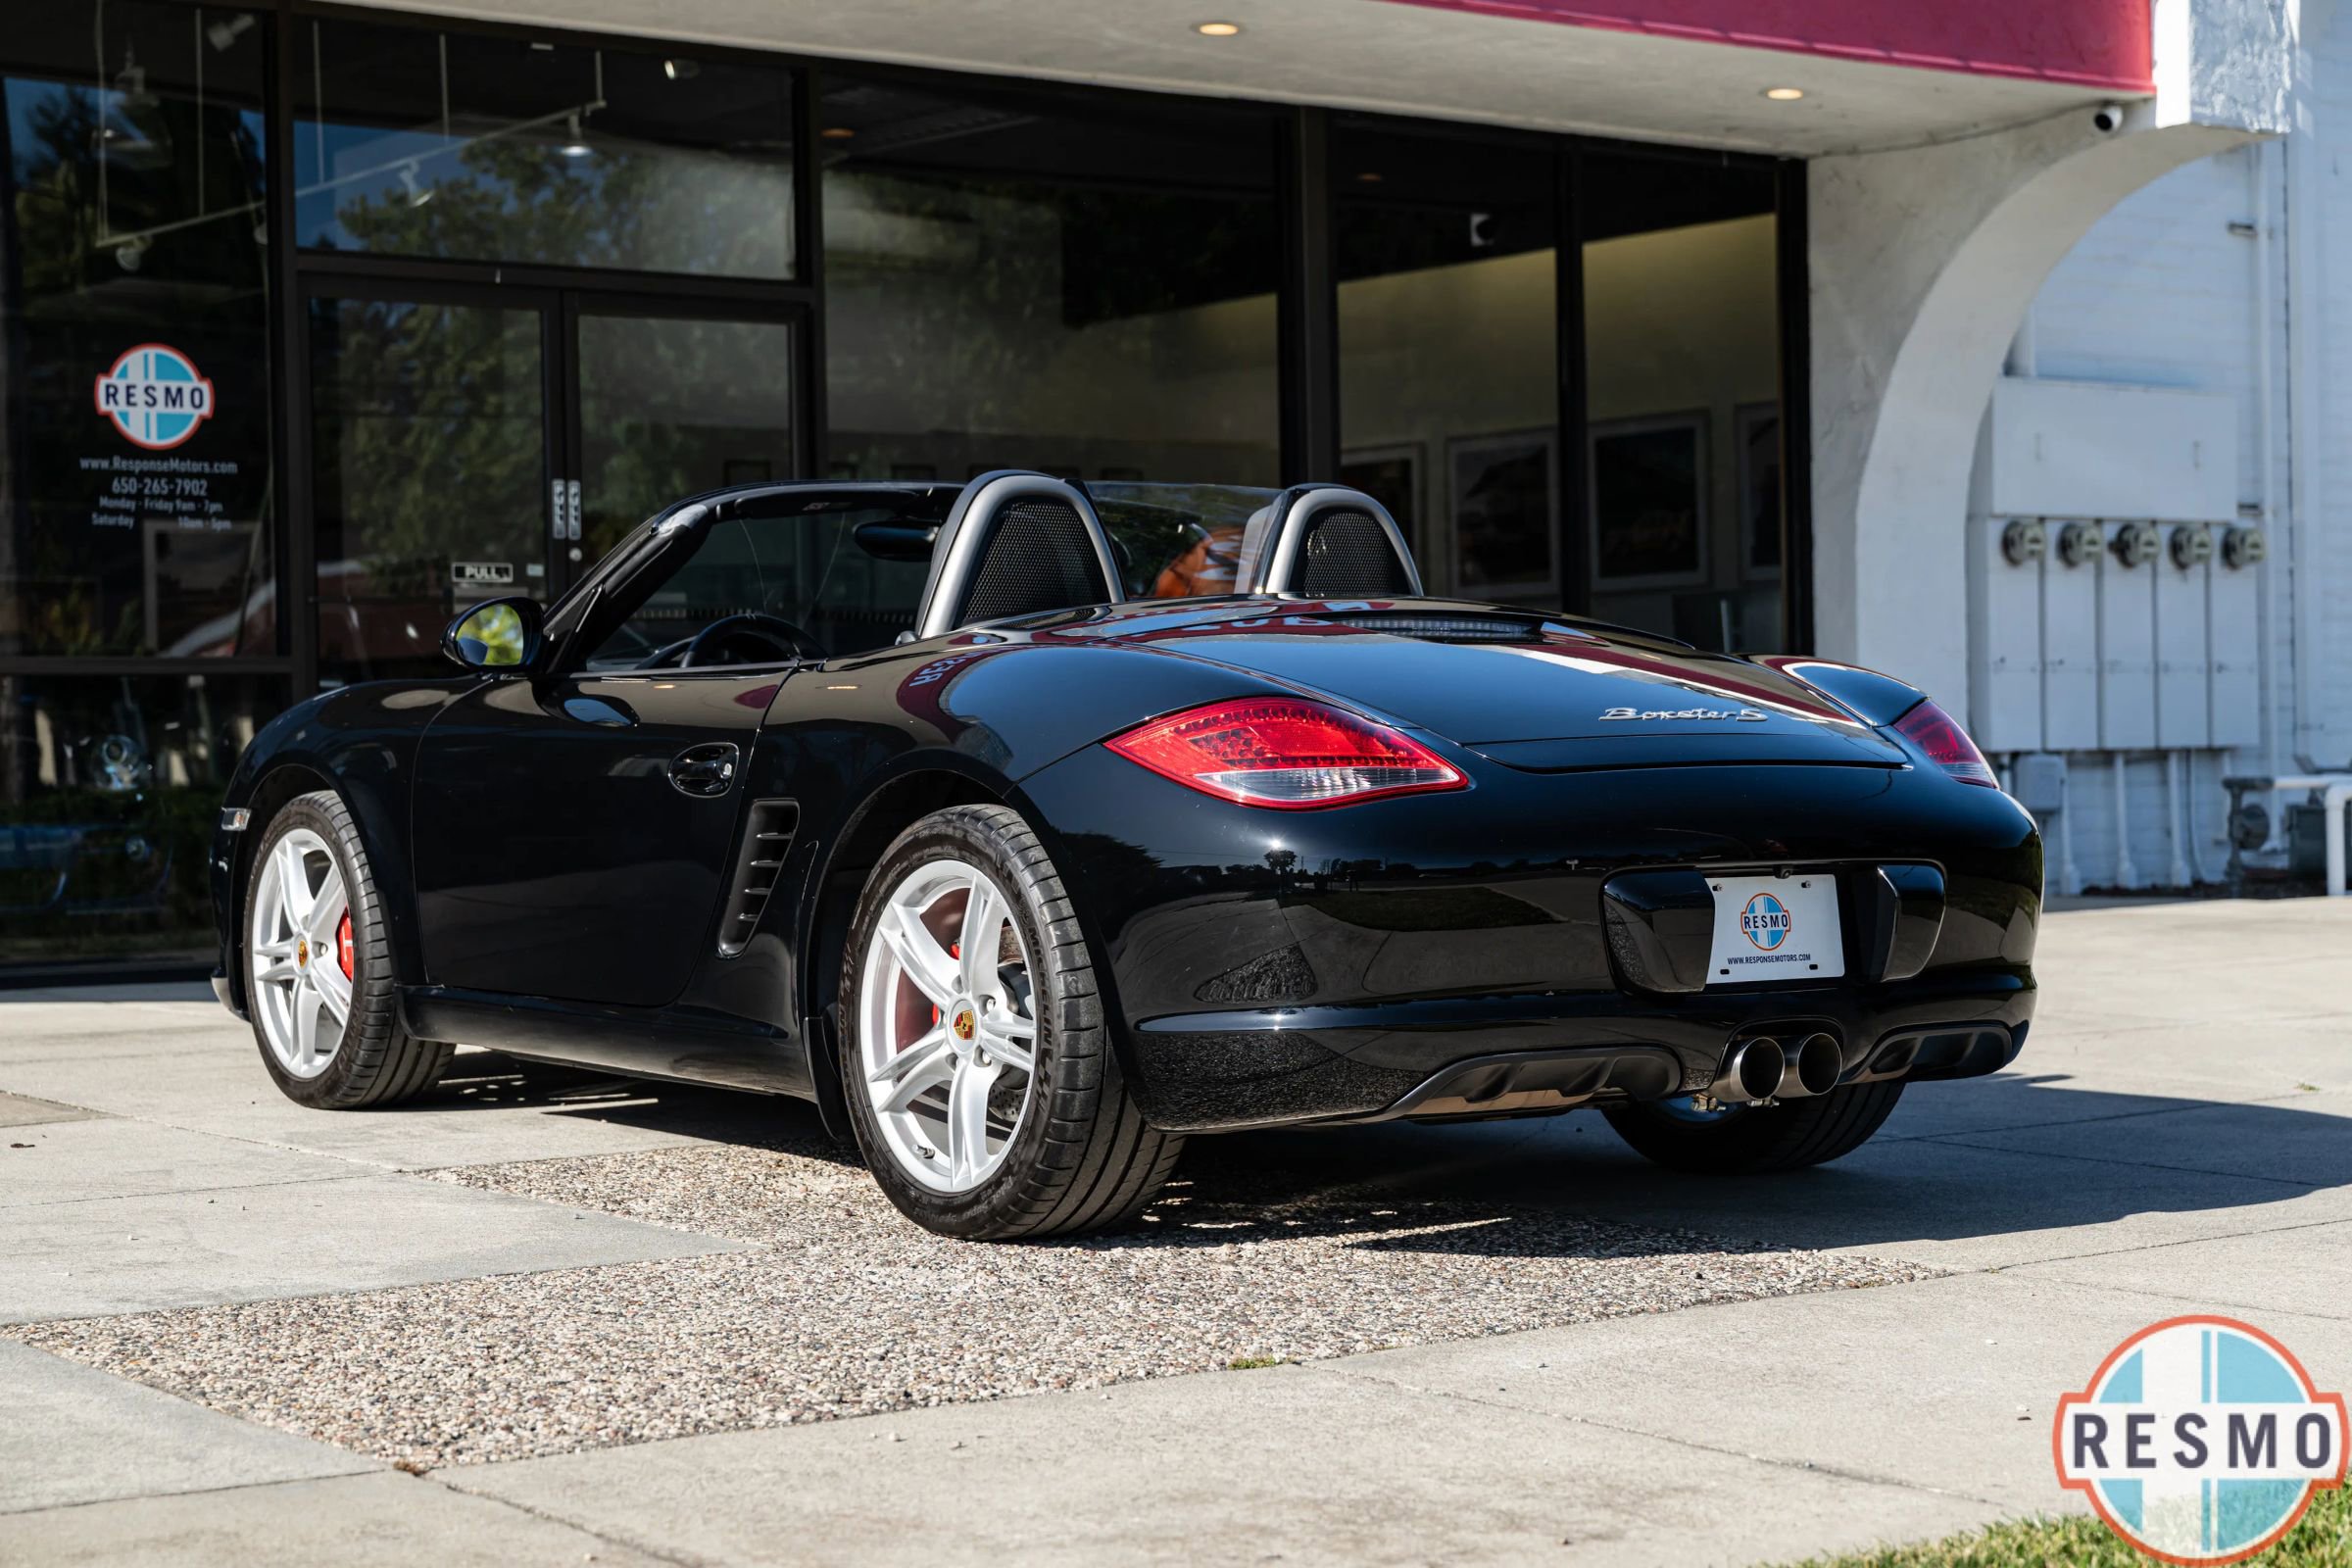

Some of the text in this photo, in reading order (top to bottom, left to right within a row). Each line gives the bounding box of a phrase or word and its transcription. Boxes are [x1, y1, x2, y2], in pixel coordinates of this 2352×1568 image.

[104, 383, 205, 410] RESMO
[79, 456, 238, 475] www.ResponseMotors.com
[112, 477, 208, 497] 650-265-7902
[99, 496, 136, 513] Monday
[144, 498, 174, 514] Friday
[204, 500, 223, 515] 7pm
[91, 513, 134, 530] Saturday
[465, 566, 496, 579] PULL
[1598, 708, 1768, 721] Boxster S
[1743, 913, 1788, 930] RESMO
[1727, 954, 1811, 965] WWW.RESPONSEMOTORS.COM
[1030, 928, 1054, 1047] MICHELIN
